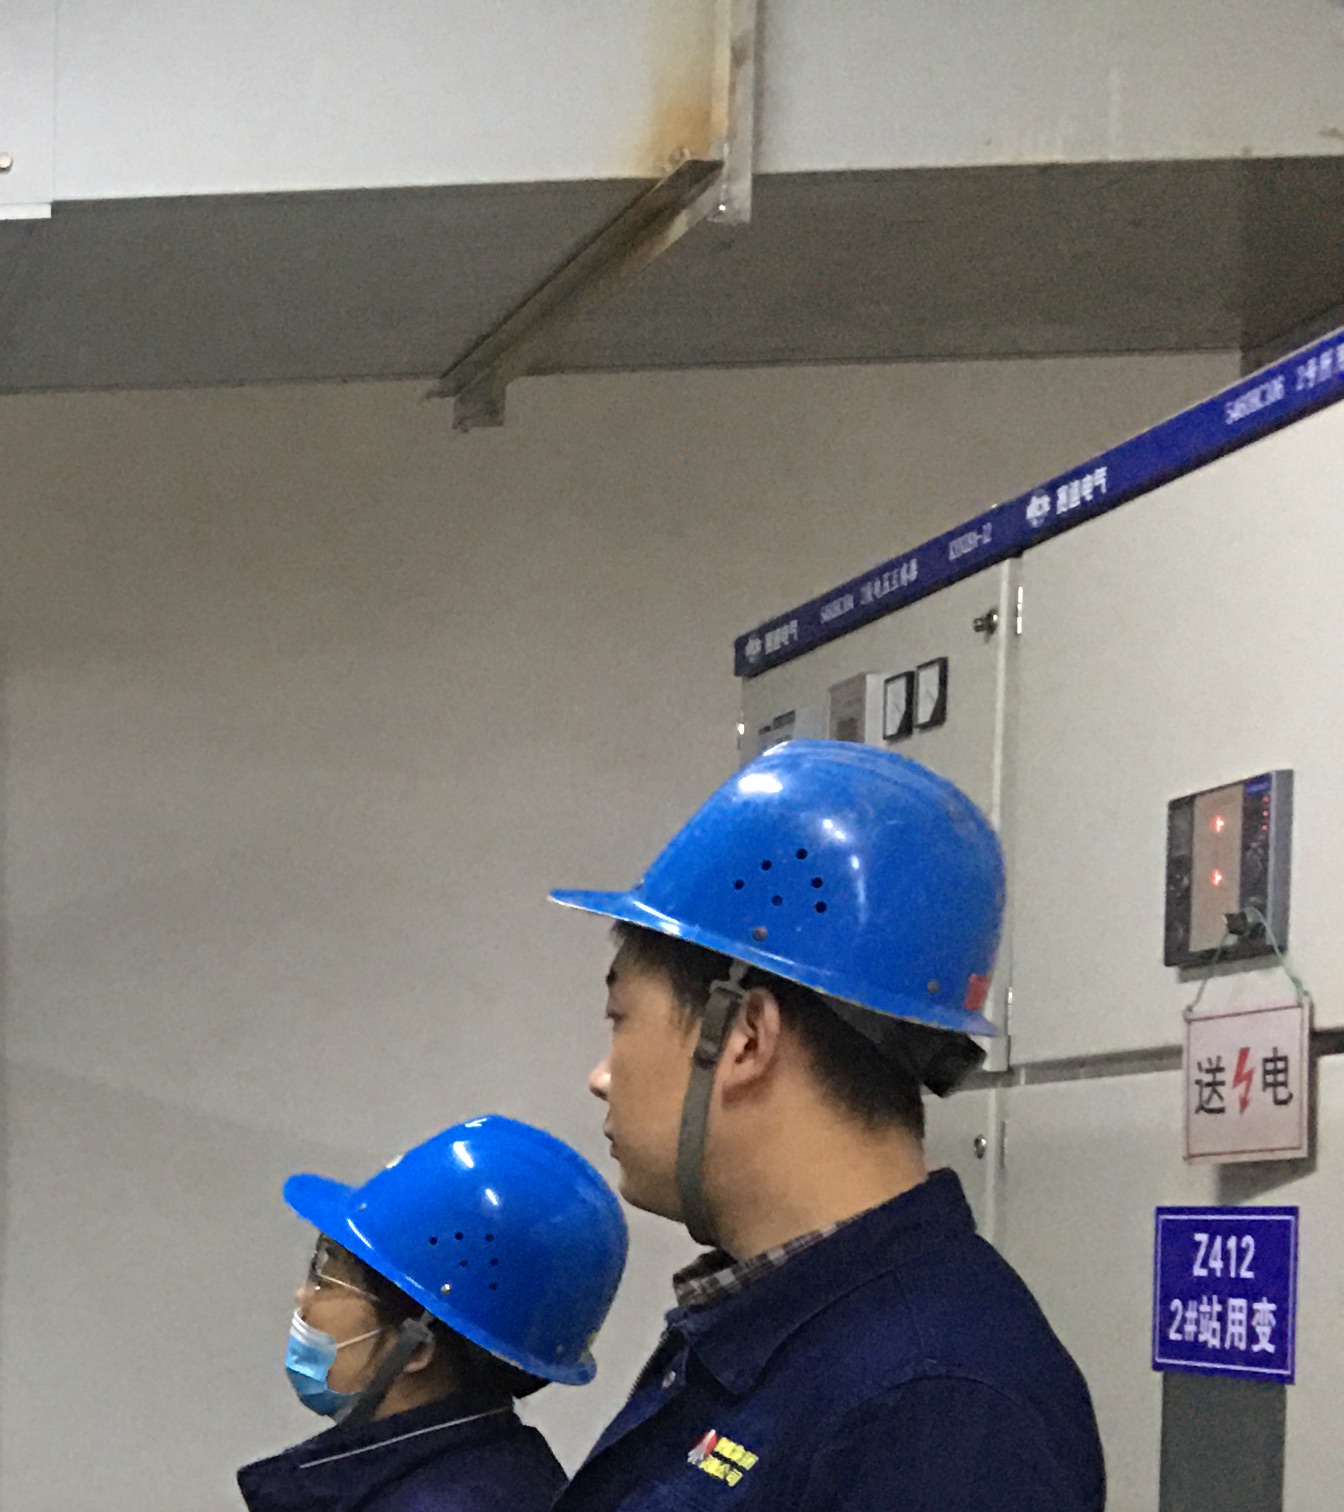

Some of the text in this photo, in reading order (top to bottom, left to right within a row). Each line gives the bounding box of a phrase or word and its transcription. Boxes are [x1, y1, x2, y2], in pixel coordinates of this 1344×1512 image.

[1192, 1232, 1256, 1279] Z412
[1168, 1295, 1277, 1354] 2#站用变
